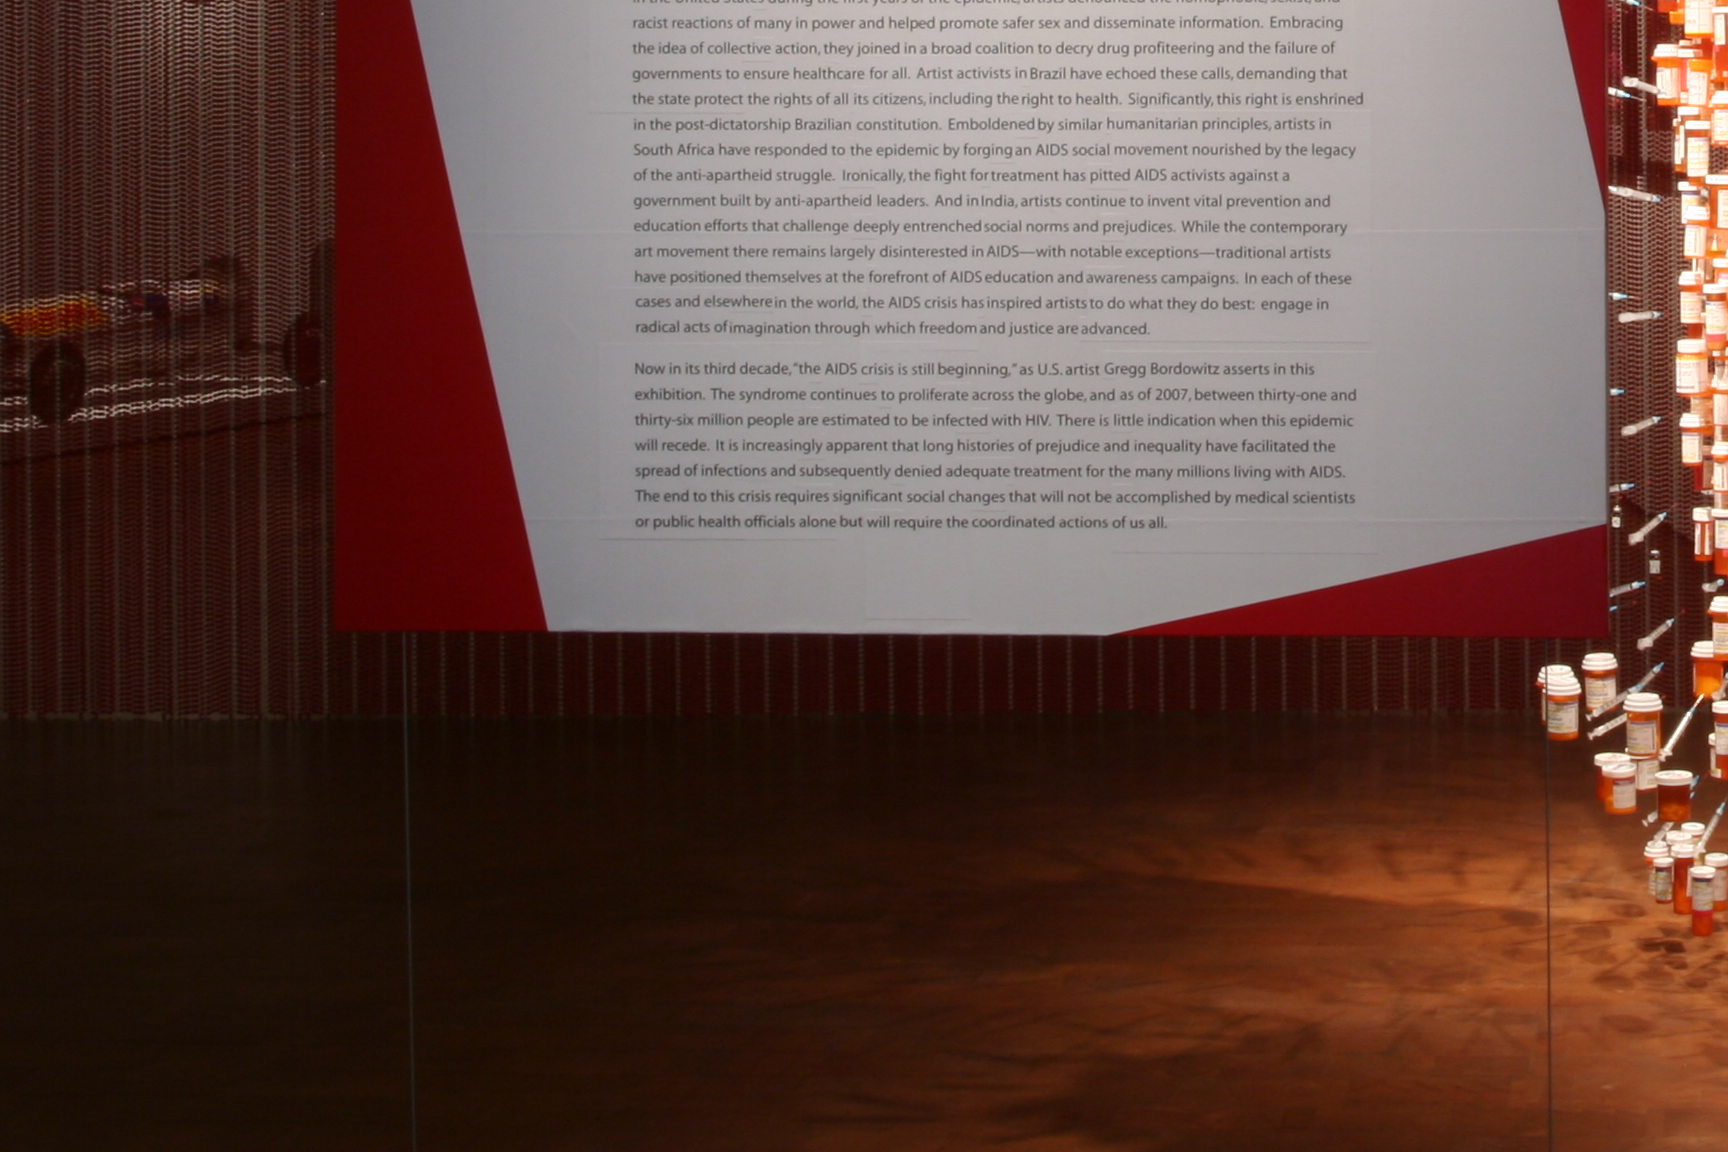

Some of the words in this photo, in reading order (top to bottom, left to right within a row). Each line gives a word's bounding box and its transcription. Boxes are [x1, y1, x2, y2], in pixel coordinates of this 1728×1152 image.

[632, 68, 723, 83] governments
[724, 68, 741, 80] to
[742, 69, 791, 81] ensure
[792, 66, 866, 81] healthcare
[868, 66, 889, 80] for
[891, 66, 911, 80] all.
[915, 66, 954, 80] Artist
[956, 66, 1012, 80] activists
[1014, 66, 1028, 79] in
[1029, 66, 1067, 81] Brazil
[1069, 66, 1103, 81] have
[1105, 66, 1157, 80] echoed
[1159, 66, 1199, 80] these
[1200, 66, 1235, 81] calls,
[1235, 66, 1317, 84] demanding
[1319, 66, 1348, 80] that
[633, 143, 674, 157] South
[676, 142, 715, 156] Africa
[718, 142, 752, 156] have
[754, 142, 828, 159] responded
[830, 145, 847, 157] to
[849, 143, 873, 157] the
[875, 142, 940, 160] epidemic
[942, 142, 961, 160] by
[962, 142, 1014, 160] forging
[1014, 146, 1033, 157] an
[1034, 143, 1069, 157] AIDS
[1071, 142, 1111, 157] social
[1113, 144, 1189, 156] movement
[1191, 142, 1262, 157] nourished
[1264, 142, 1283, 159] by
[1284, 142, 1309, 157] the
[1311, 142, 1357, 160] legacy
[634, 387, 706, 401] exhibition.
[709, 387, 736, 401] The
[738, 387, 807, 404] syndrome
[809, 388, 878, 401] continues
[880, 390, 896, 402] to
[898, 387, 970, 405] proliferate
[971, 390, 1015, 402] across
[1017, 388, 1042, 402] the
[1043, 387, 1088, 405] globe,
[1089, 388, 1116, 402] and
[1119, 390, 1135, 401] as
[1137, 387, 1153, 401] of
[1154, 387, 1192, 403] 2007,
[1193, 387, 1255, 402] between
[1257, 387, 1328, 405] thirty-one
[1330, 388, 1357, 402] and
[634, 489, 661, 503] The
[662, 489, 690, 503] end
[692, 491, 708, 503] to
[709, 489, 736, 503] this
[737, 489, 772, 503] crisis
[774, 489, 830, 506] requires
[832, 488, 904, 506] significant
[906, 489, 945, 504] social
[947, 489, 1006, 507] changes
[1008, 489, 1037, 503] that
[1039, 489, 1064, 503] will
[1067, 492, 1092, 504] not
[1094, 489, 1113, 504] be
[1115, 490, 1211, 507] accomplished
[1214, 490, 1232, 507] by
[1234, 490, 1290, 505] medical
[1292, 490, 1356, 505] scientists
